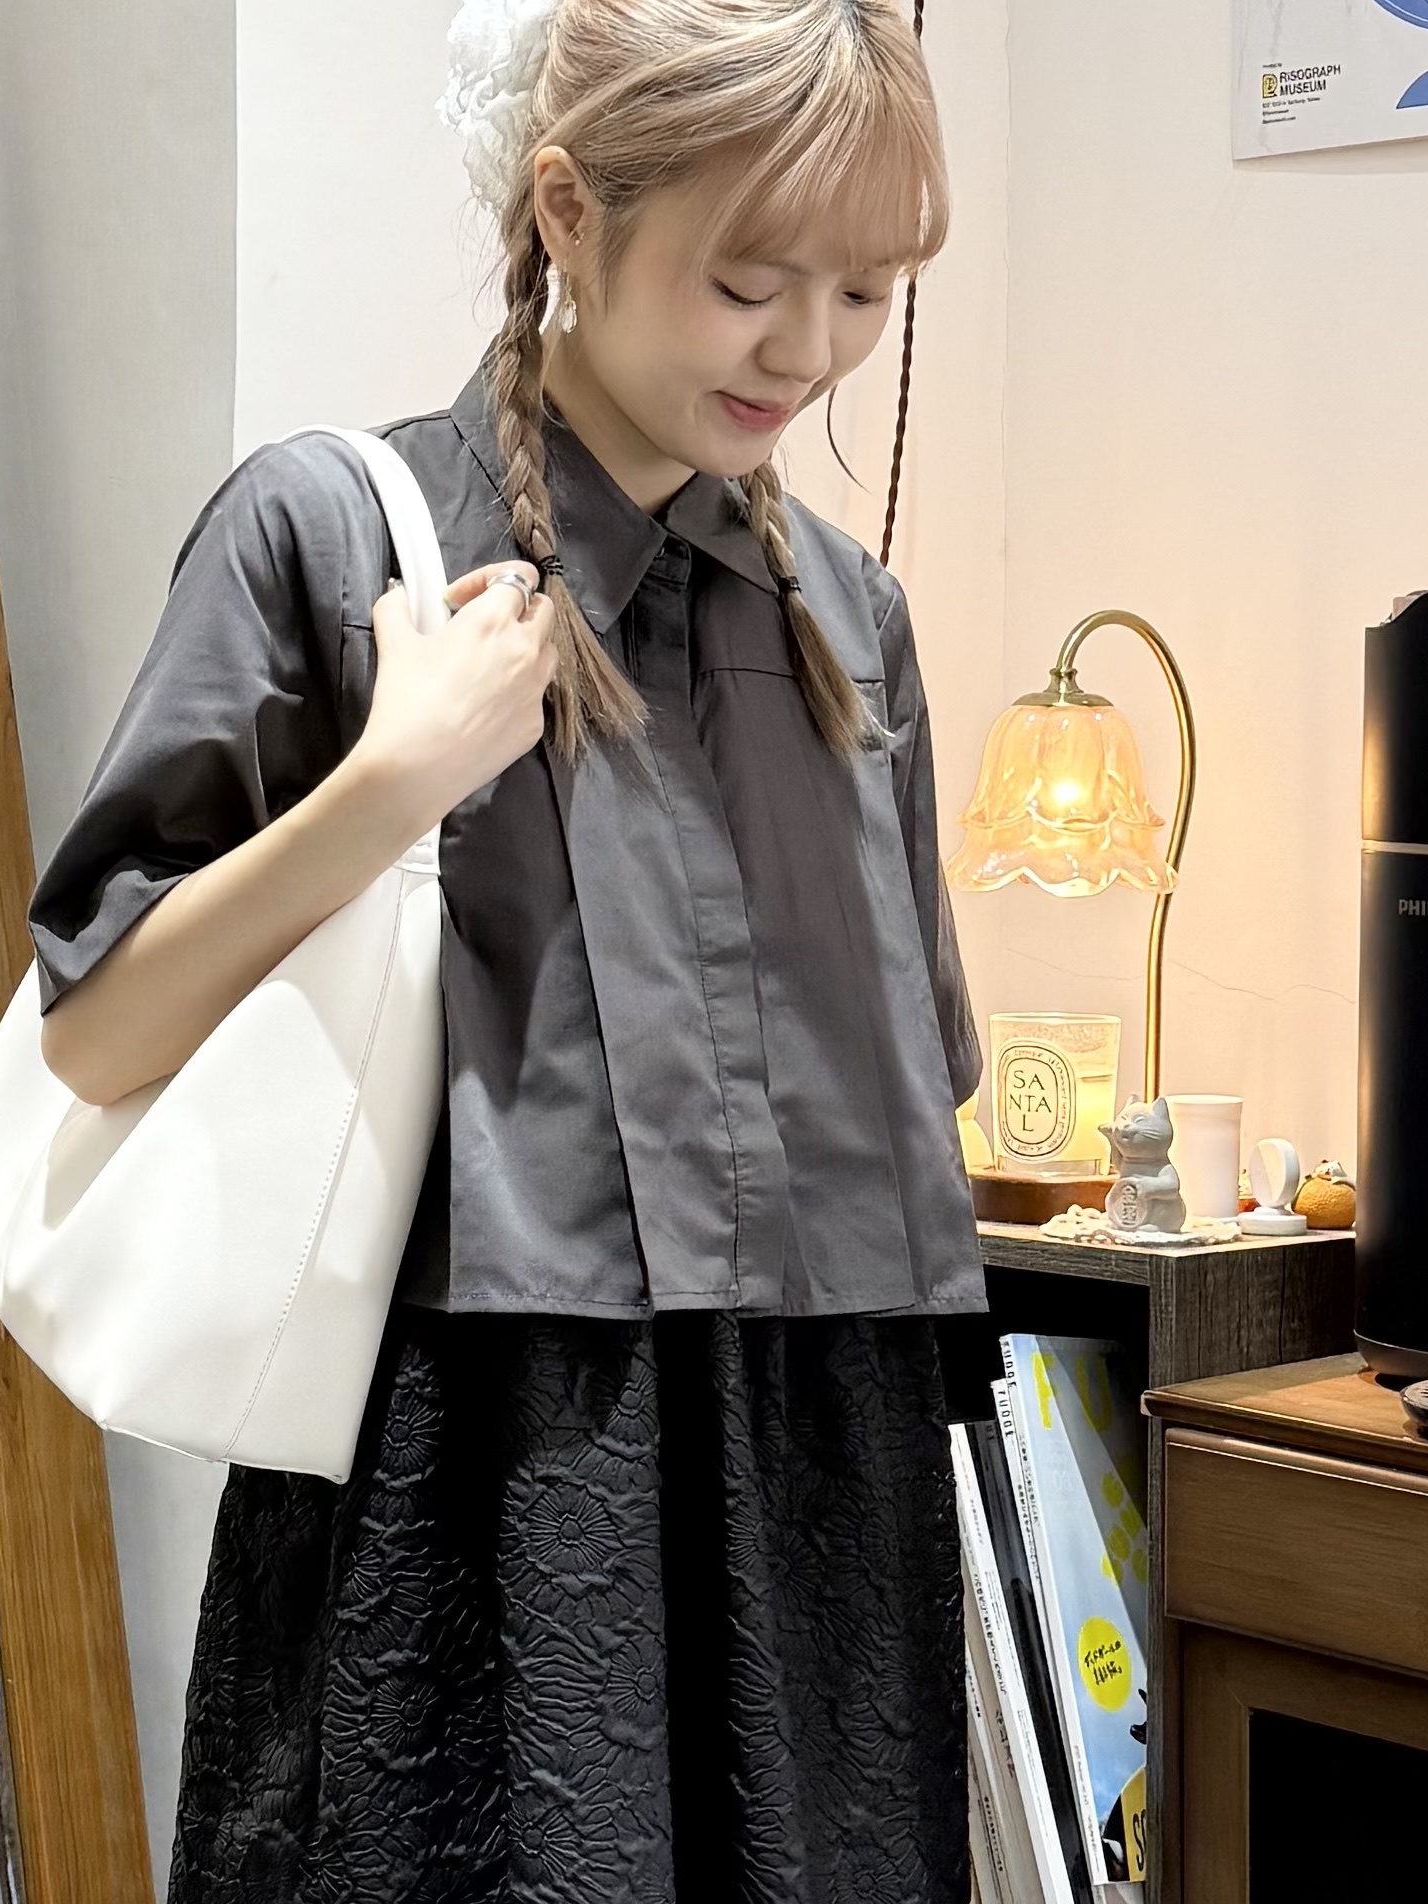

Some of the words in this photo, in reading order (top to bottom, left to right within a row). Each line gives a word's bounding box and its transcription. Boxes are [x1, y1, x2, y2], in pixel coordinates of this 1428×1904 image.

[1279, 79, 1327, 96] MUSEUM
[1013, 1070, 1045, 1091] SA
[1009, 1093, 1052, 1114] NTA
[1022, 1114, 1035, 1132] L
